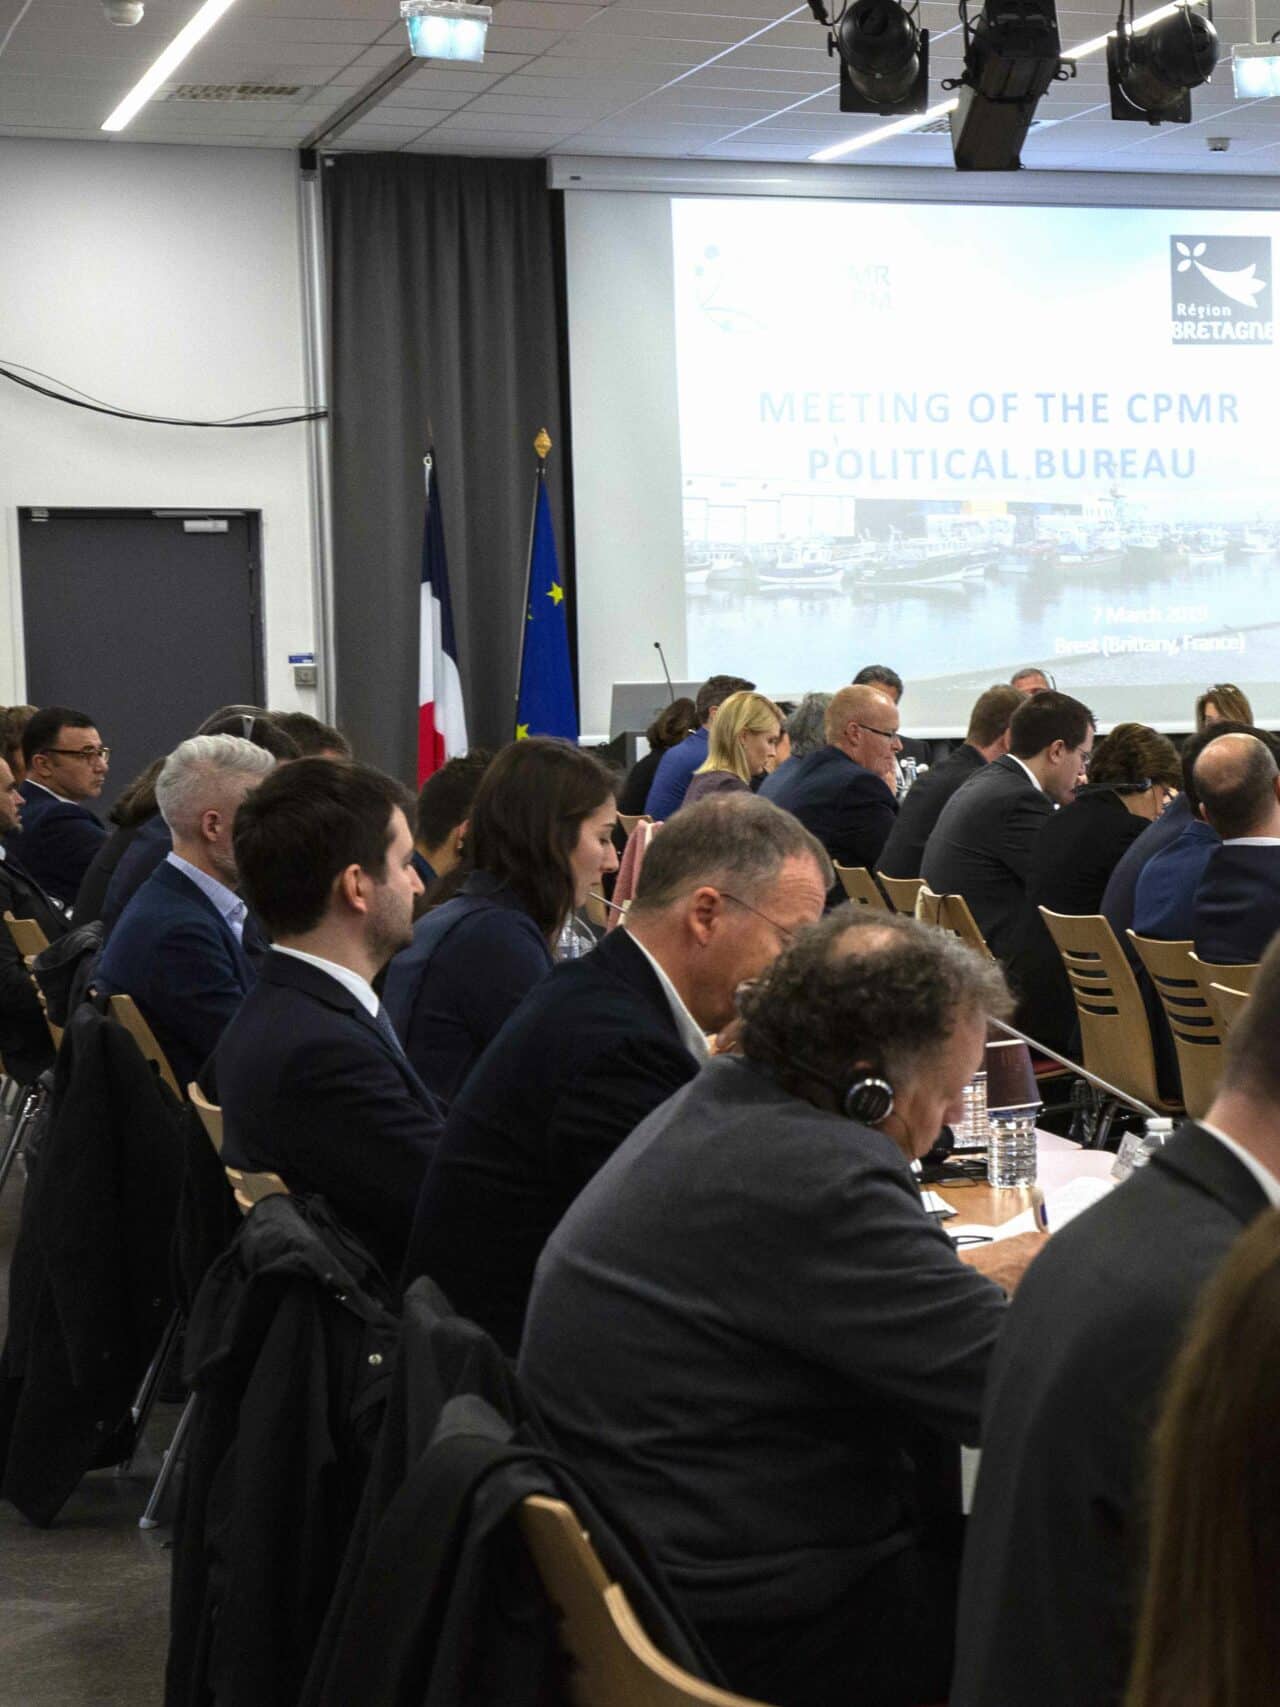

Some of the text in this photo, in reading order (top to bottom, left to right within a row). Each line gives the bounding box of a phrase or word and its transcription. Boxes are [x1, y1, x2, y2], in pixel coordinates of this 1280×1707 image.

[1176, 303, 1232, 318] Région
[758, 391, 1239, 423] MEETING OF THE CPMR
[807, 448, 1196, 480] POLITICAL BUREAU
[1105, 604, 1162, 624] March
[1055, 637, 1099, 653] Brest
